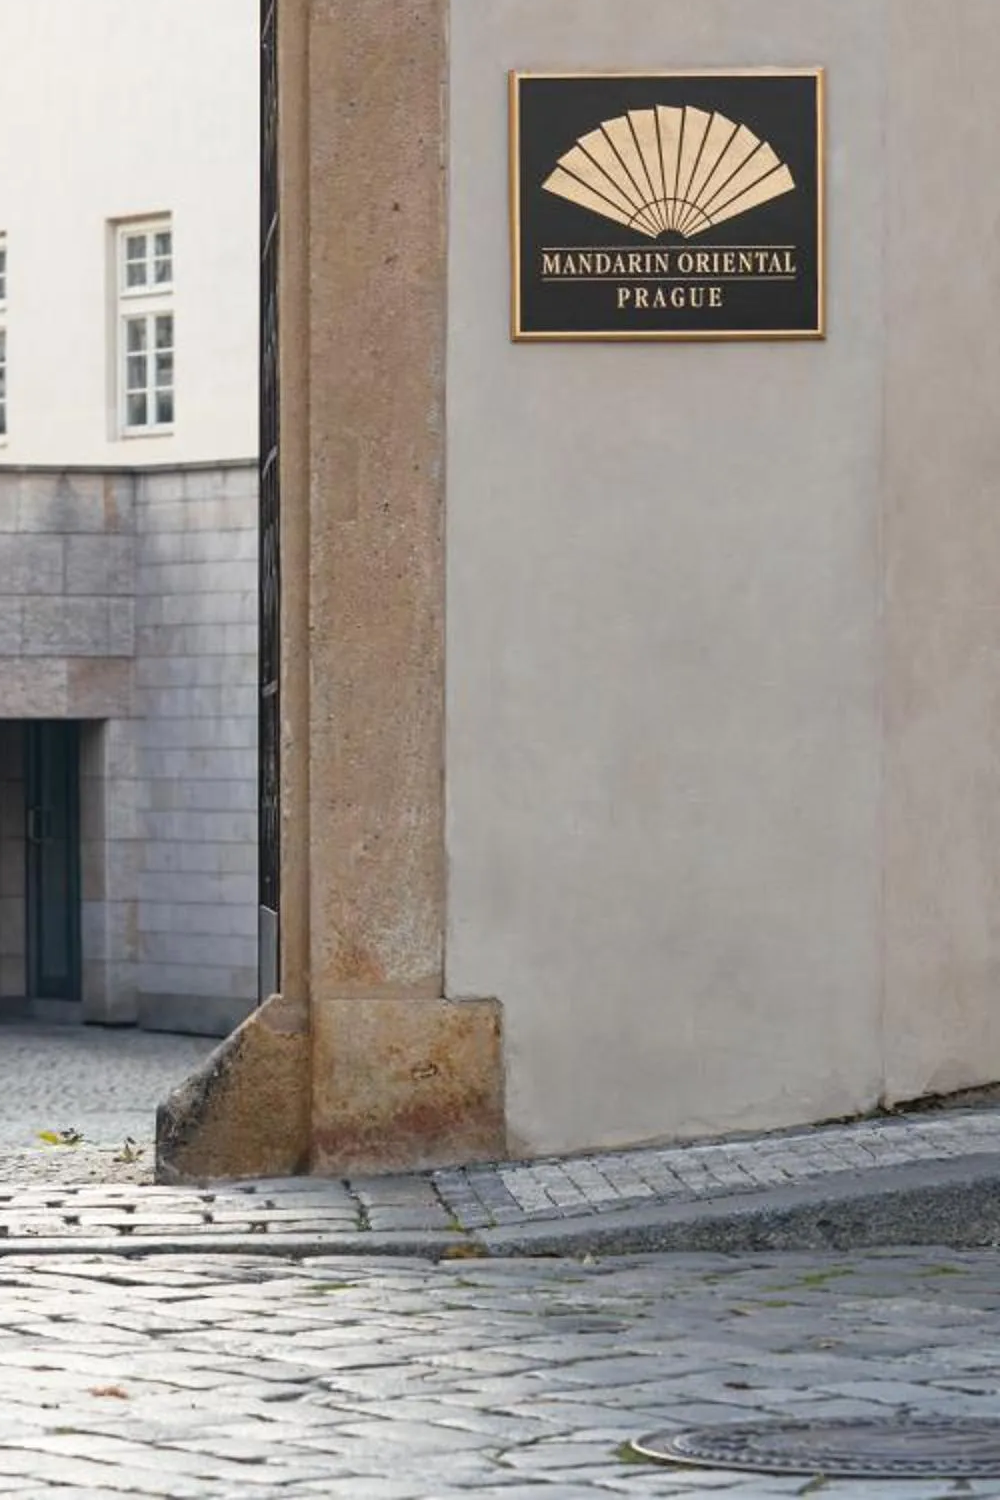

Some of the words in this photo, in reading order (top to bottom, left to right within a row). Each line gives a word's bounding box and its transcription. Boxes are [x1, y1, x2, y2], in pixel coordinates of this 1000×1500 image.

[542, 253, 669, 274] MANDARIN
[677, 252, 796, 273] ORIENTAL
[617, 287, 723, 308] PRAGUE
